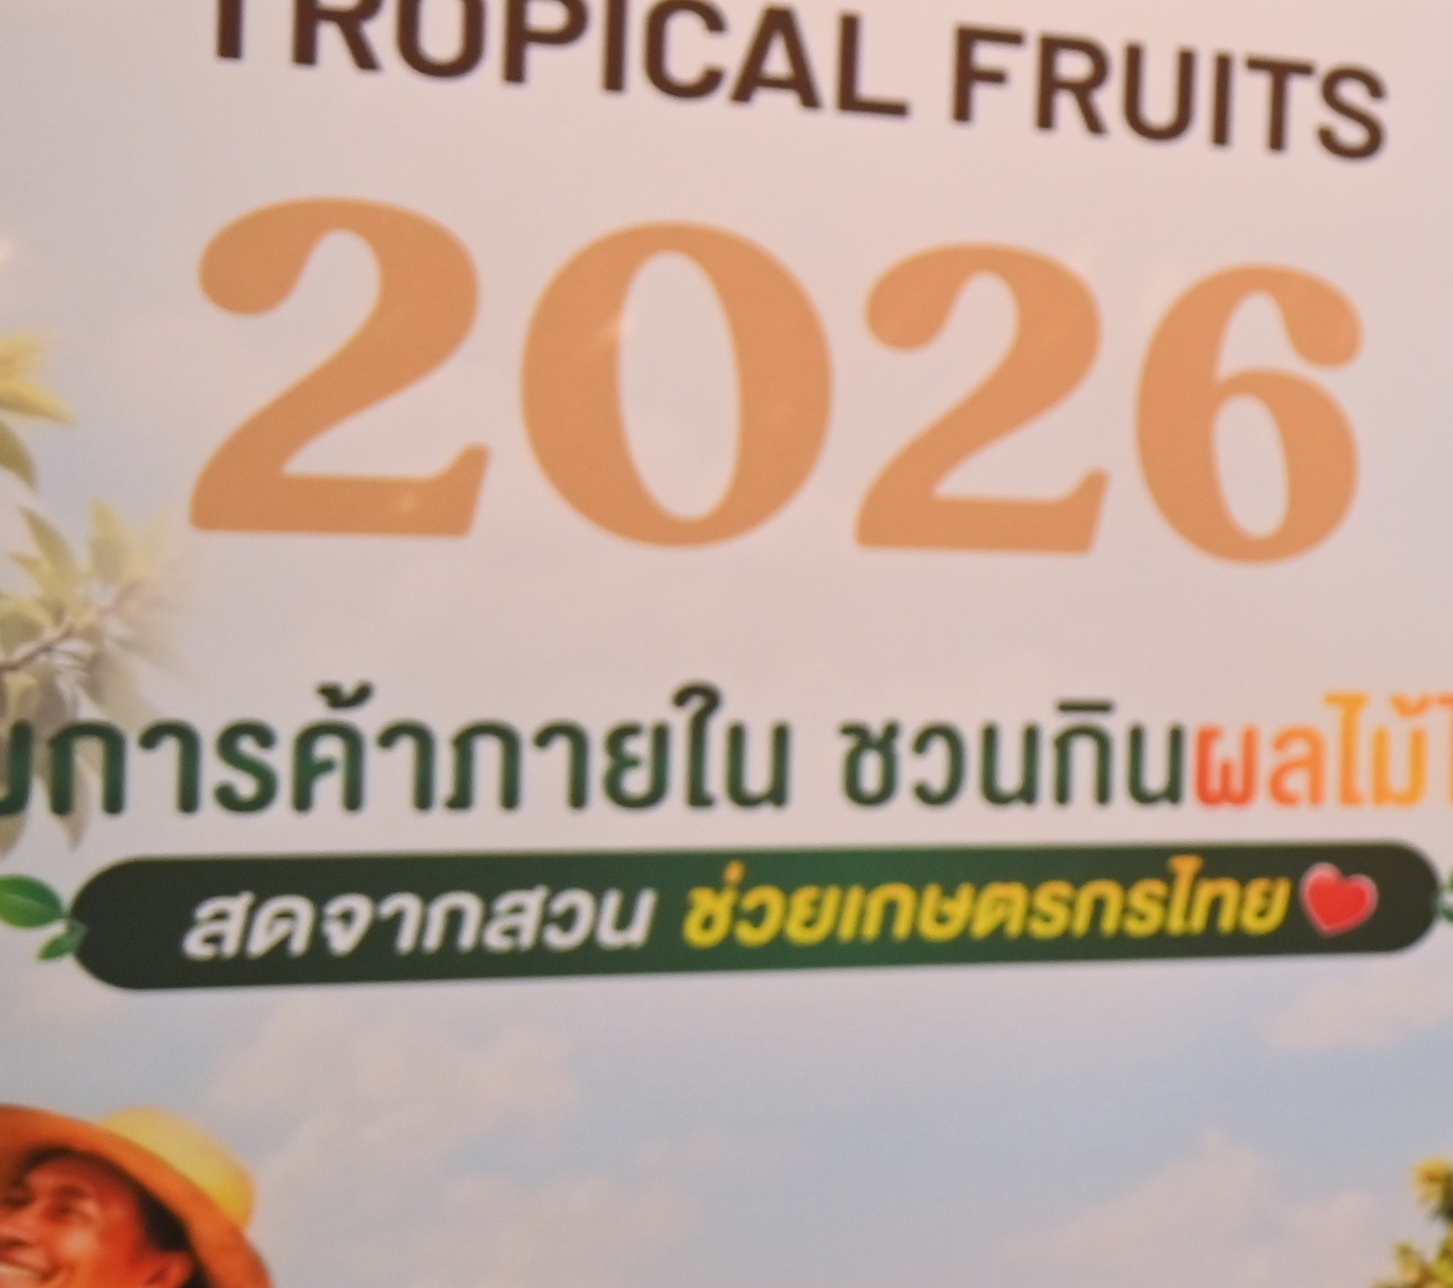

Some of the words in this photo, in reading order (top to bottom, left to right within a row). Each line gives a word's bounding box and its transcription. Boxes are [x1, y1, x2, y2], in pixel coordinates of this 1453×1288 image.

[951, 24, 1390, 163] FRUITS
[188, 196, 1366, 566] 2026
[182, 886, 656, 961] สดจากสวน
[683, 854, 1293, 948] ช่วยเกษตรกรไทย
